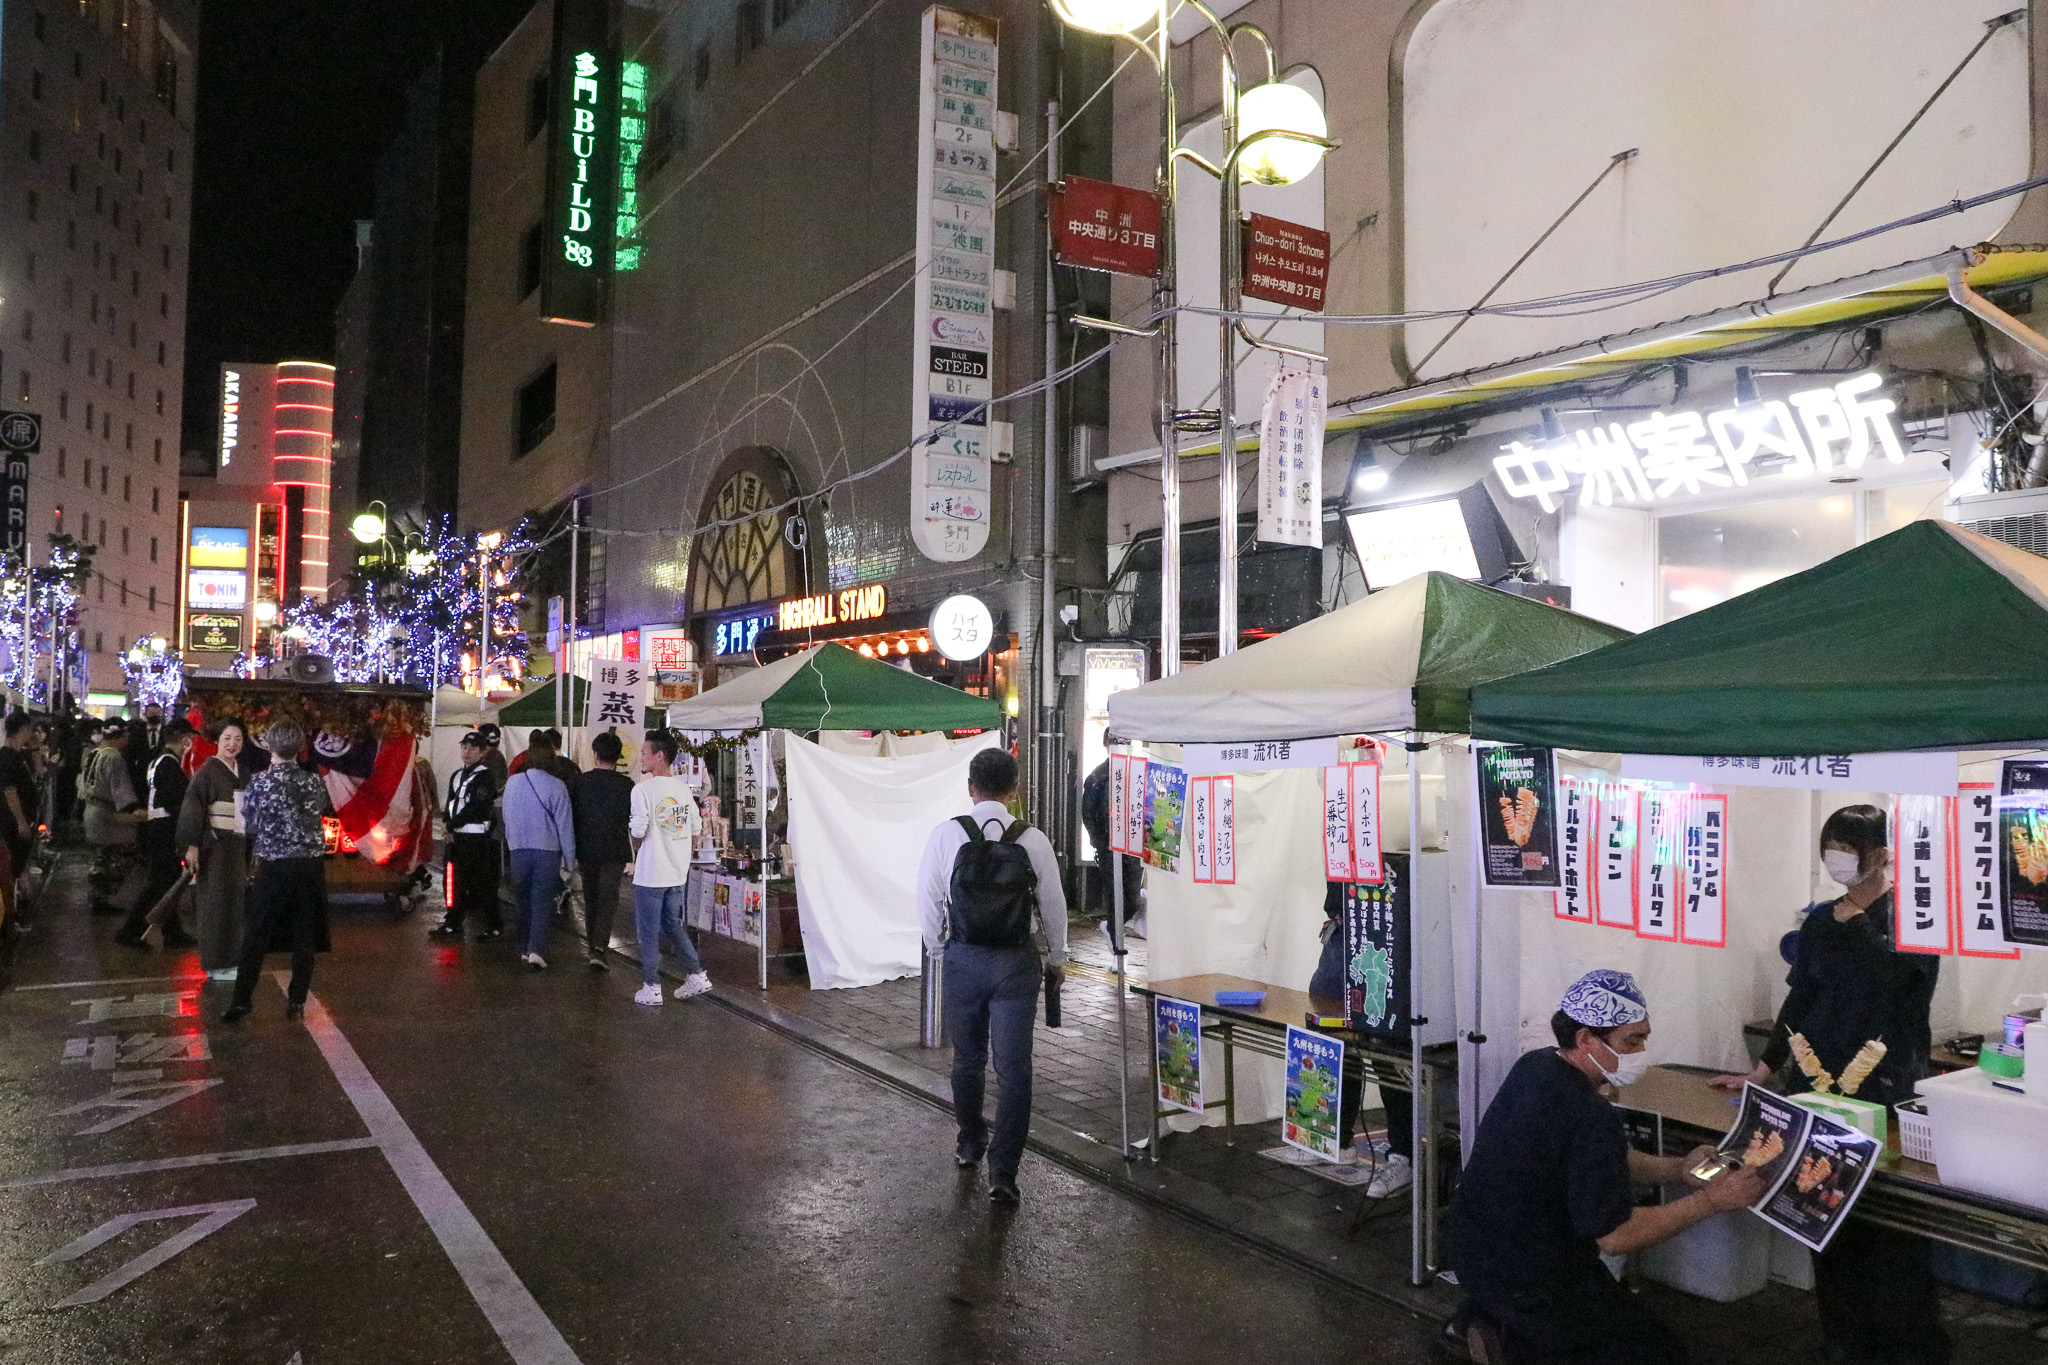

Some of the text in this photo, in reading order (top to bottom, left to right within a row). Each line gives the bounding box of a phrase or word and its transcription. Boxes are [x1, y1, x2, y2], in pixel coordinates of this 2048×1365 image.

[574, 52, 599, 104] 多門
[955, 127, 973, 143] 2F
[1095, 208, 1132, 228] 中洲
[1068, 220, 1156, 249] 中央通り3丁目
[1255, 231, 1325, 259] Chuo-dori 3chome
[563, 235, 593, 267] '83
[1255, 252, 1276, 266] 나카스
[1277, 257, 1305, 274] 추오도리
[933, 294, 986, 314] おむすび村
[951, 351, 968, 361] BAR
[934, 358, 984, 377] STEED
[946, 377, 972, 394] B1F
[222, 370, 240, 448] AKADAMA
[5, 419, 32, 444] 源
[953, 439, 980, 456] くに
[1492, 372, 1905, 514] 中洲案内所
[7, 460, 27, 548] MARU
[944, 524, 969, 541] 多門
[198, 541, 240, 553] PEACE
[944, 541, 968, 554] ビル
[779, 584, 885, 631] HIGHBALL STAND
[952, 613, 978, 625] ハイ
[952, 627, 978, 642] スタ
[600, 667, 641, 687] 博多
[671, 674, 691, 683] フリー
[597, 691, 636, 724] 蒸
[1253, 741, 1291, 762] 流れ者
[1499, 770, 1533, 780] POTATO
[1326, 799, 1337, 854] 一番搾り
[1337, 788, 1348, 844] 生ビール
[1360, 787, 1372, 848] ハイボール
[1565, 789, 1580, 916] トルネードポテト
[1973, 794, 1995, 931] サワークリーム
